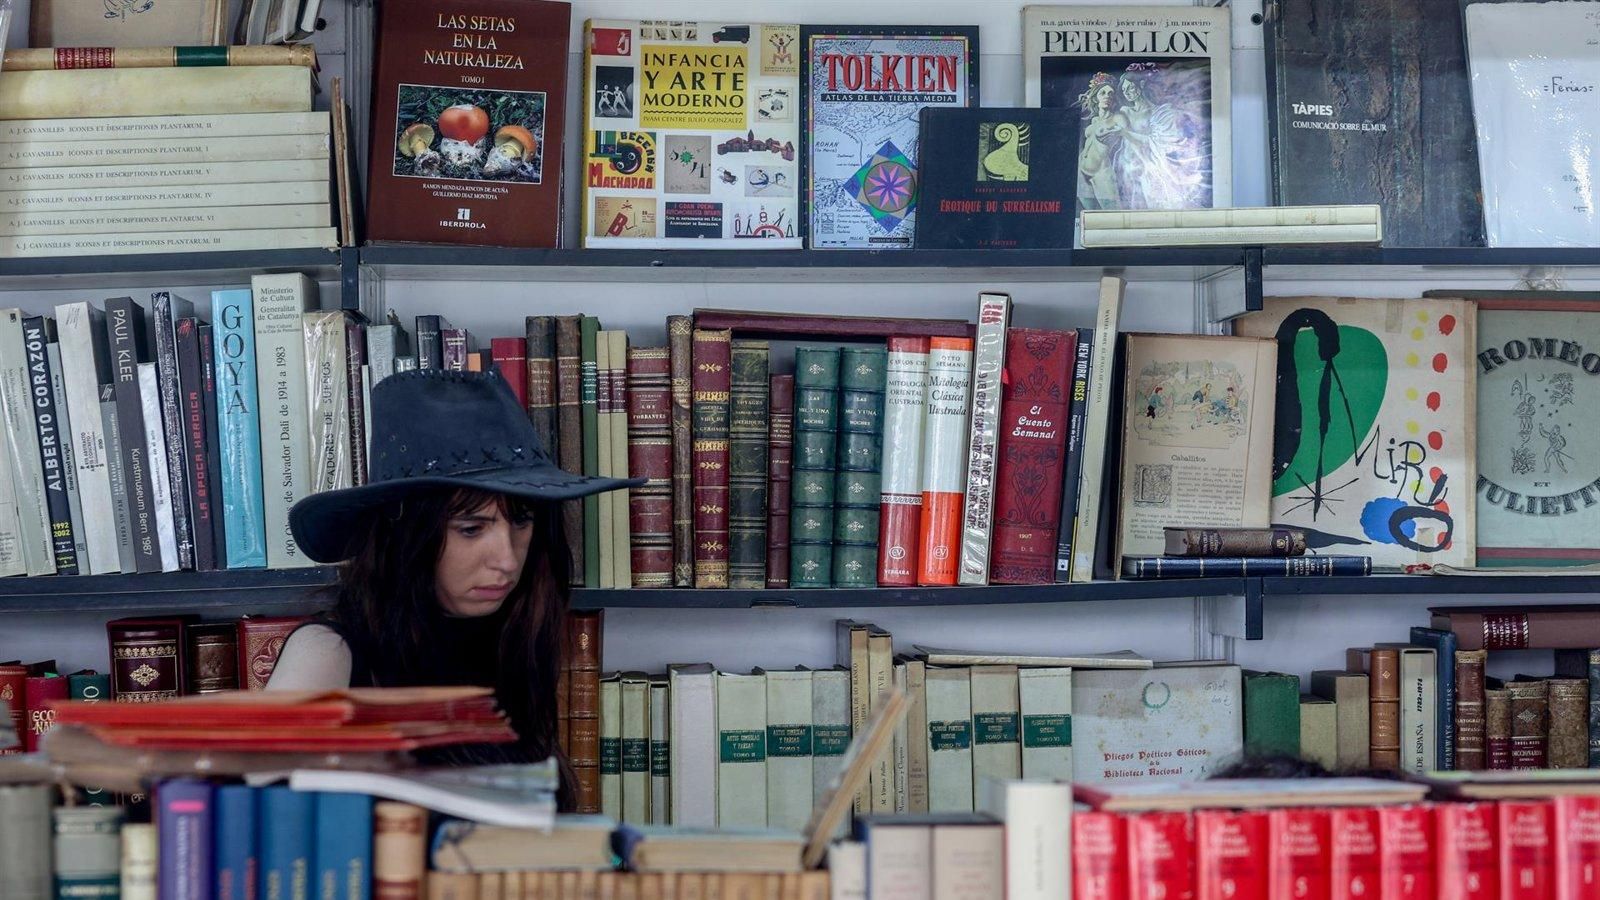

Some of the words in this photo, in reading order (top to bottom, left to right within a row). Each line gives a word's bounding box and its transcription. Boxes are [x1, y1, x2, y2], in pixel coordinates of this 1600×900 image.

[437, 14, 466, 29] LAS
[471, 16, 515, 32] SETAS
[454, 34, 472, 48] EN
[478, 36, 497, 49] LA
[1041, 31, 1210, 53] PERELLON
[424, 50, 524, 69] NATURALEZA
[644, 53, 745, 68] INFANCIA
[645, 71, 659, 89] Y
[670, 71, 744, 91] ARTE
[820, 54, 958, 92] TOLKIEN
[643, 94, 744, 108] MODERNO
[1292, 102, 1333, 116] TÀPIES
[1293, 121, 1339, 129] COMUNICACIÓ
[940, 200, 981, 214] ÉROTIQUE
[986, 200, 998, 213] DU
[1003, 199, 1060, 213] SURRÉALISME
[112, 309, 129, 344] PAUL
[274, 345, 286, 367] 1983
[1078, 342, 1089, 358] NEW
[27, 327, 50, 408] CORAZÓN
[117, 350, 133, 382] KLEE
[221, 304, 250, 415] GOYA
[1076, 359, 1088, 379] YORK
[277, 380, 288, 400] 1914
[929, 376, 968, 389] Mitología
[1074, 381, 1086, 401] RISES
[931, 390, 963, 402] Clásica
[279, 403, 289, 416] de
[323, 411, 332, 424] DE
[928, 404, 967, 416] Ilustrada
[1029, 405, 1042, 416] El
[278, 419, 290, 440] Dalí
[1018, 416, 1052, 428] Cuento
[1012, 426, 1056, 440] Semanal
[39, 412, 63, 492] ALBERTO
[280, 444, 293, 487] Salvador
[131, 448, 148, 510] Kunstmuseum
[283, 490, 293, 502] de
[198, 501, 209, 519] LA
[138, 512, 150, 534] Bern
[54, 529, 70, 538] 2002
[143, 536, 152, 556] 1987
[286, 538, 296, 557] 400
[1415, 723, 1424, 753] ESPAÑA
[1444, 724, 1453, 767] TRAMWAYS
[1104, 752, 1134, 762] Pliegos
[1138, 750, 1172, 761] Poéticos
[1416, 756, 1423, 767] DE
[1104, 769, 1144, 778] Biblioteca
[1149, 767, 1182, 776] Nacional
[1402, 874, 1415, 893] 7
